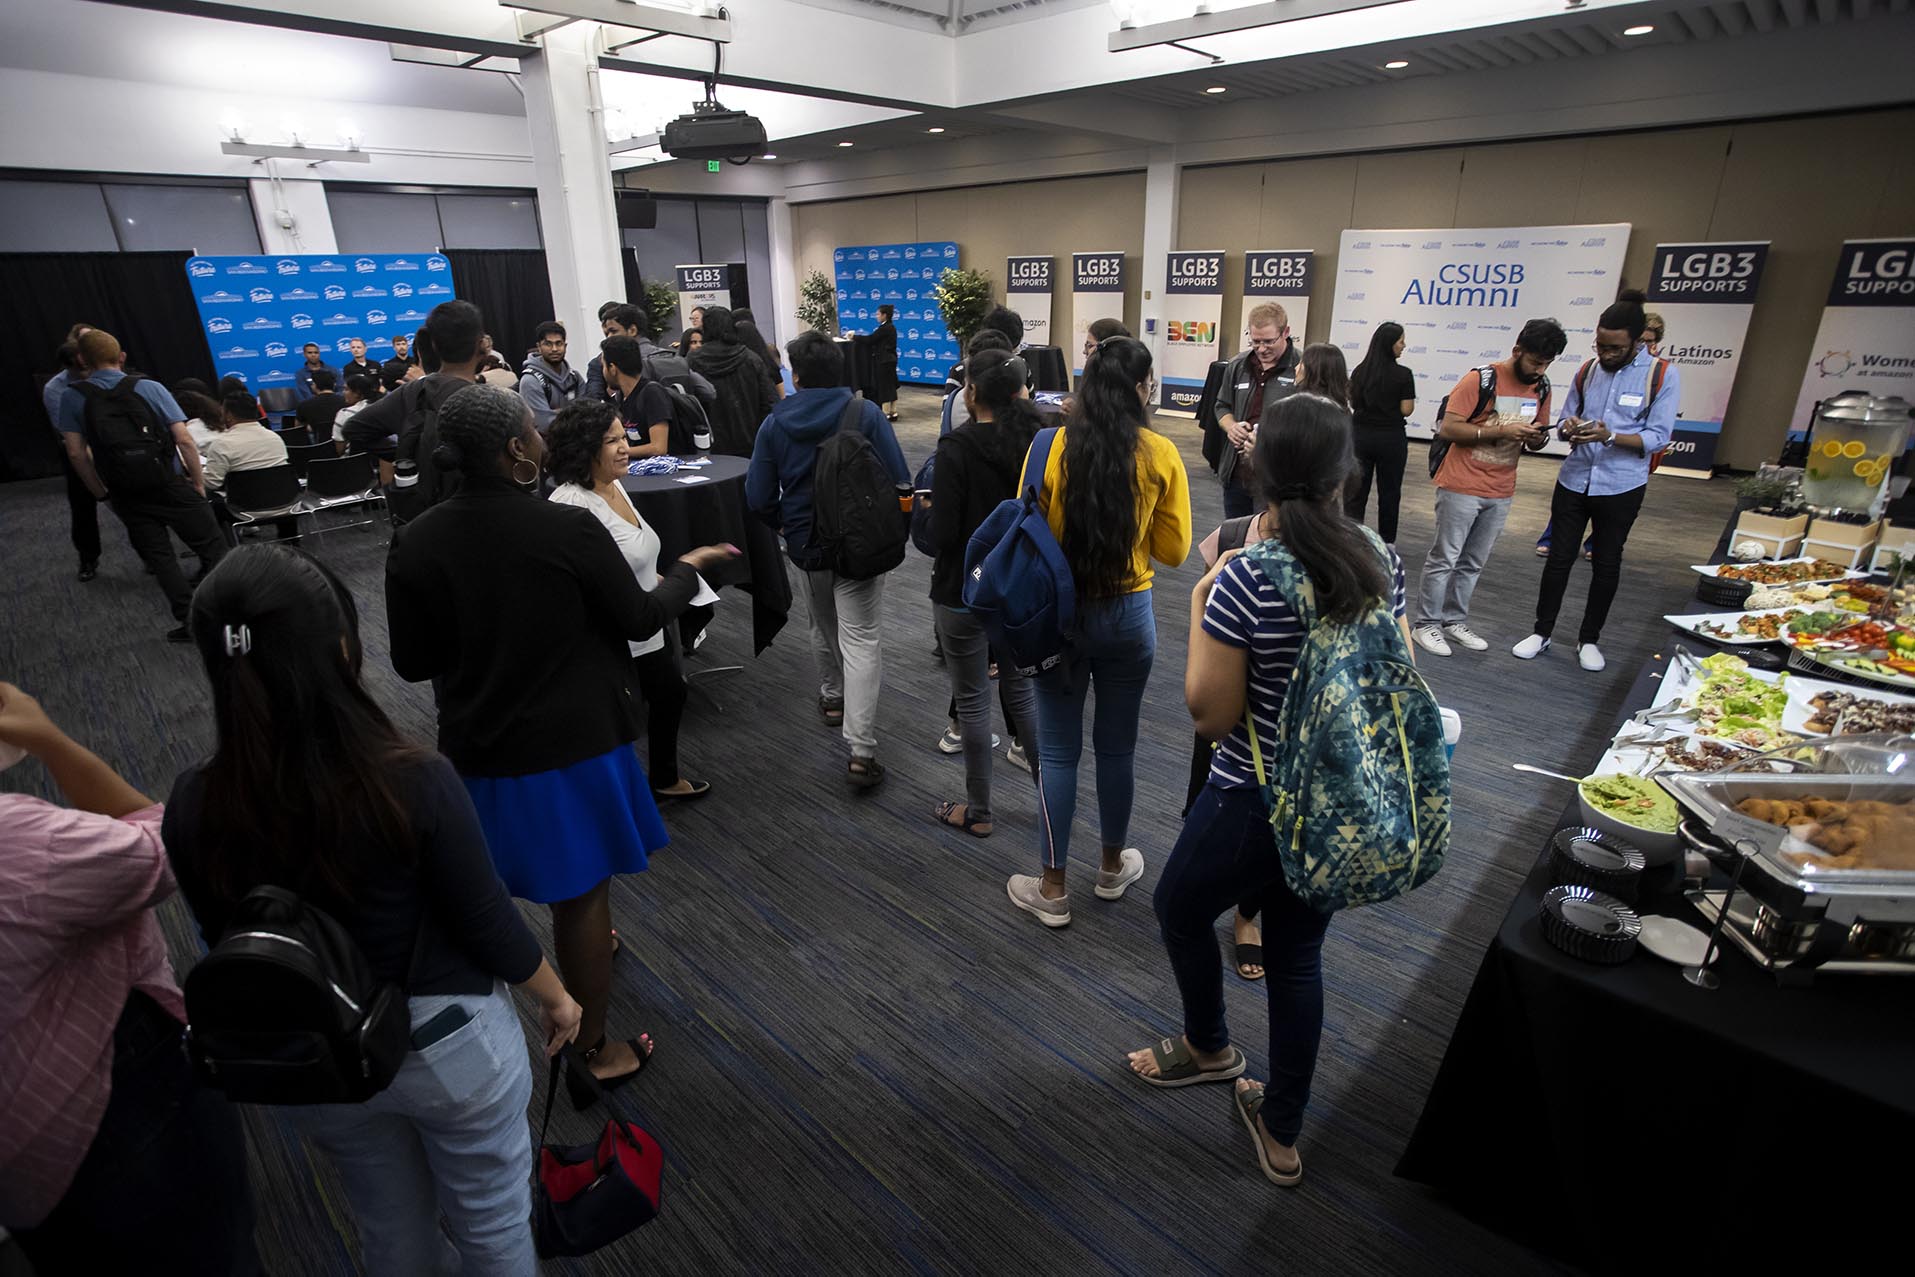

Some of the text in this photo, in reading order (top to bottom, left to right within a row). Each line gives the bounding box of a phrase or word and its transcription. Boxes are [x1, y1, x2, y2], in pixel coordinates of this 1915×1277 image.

[1011, 262, 1049, 278] LGB3
[1078, 259, 1120, 276] LGB3
[1172, 258, 1219, 276] LGB3
[1251, 258, 1306, 277] LGB3
[1662, 253, 1756, 278] LGB3
[684, 269, 721, 282] LGB3
[1078, 276, 1119, 285] SUPPORTS
[1439, 264, 1525, 284] CSUSB
[1011, 278, 1048, 287] SUPPORTS
[1171, 277, 1217, 286] SUPPORTS
[1251, 278, 1304, 288] SUPPORTS
[1659, 280, 1748, 292] SUPPORTS
[1400, 279, 1520, 307] Alumni
[1167, 321, 1216, 343] BEN
[1669, 344, 1733, 359] Latinos
[1678, 358, 1715, 366] Amazon
[1171, 392, 1202, 403] amazo
[1667, 441, 1696, 453] zon
